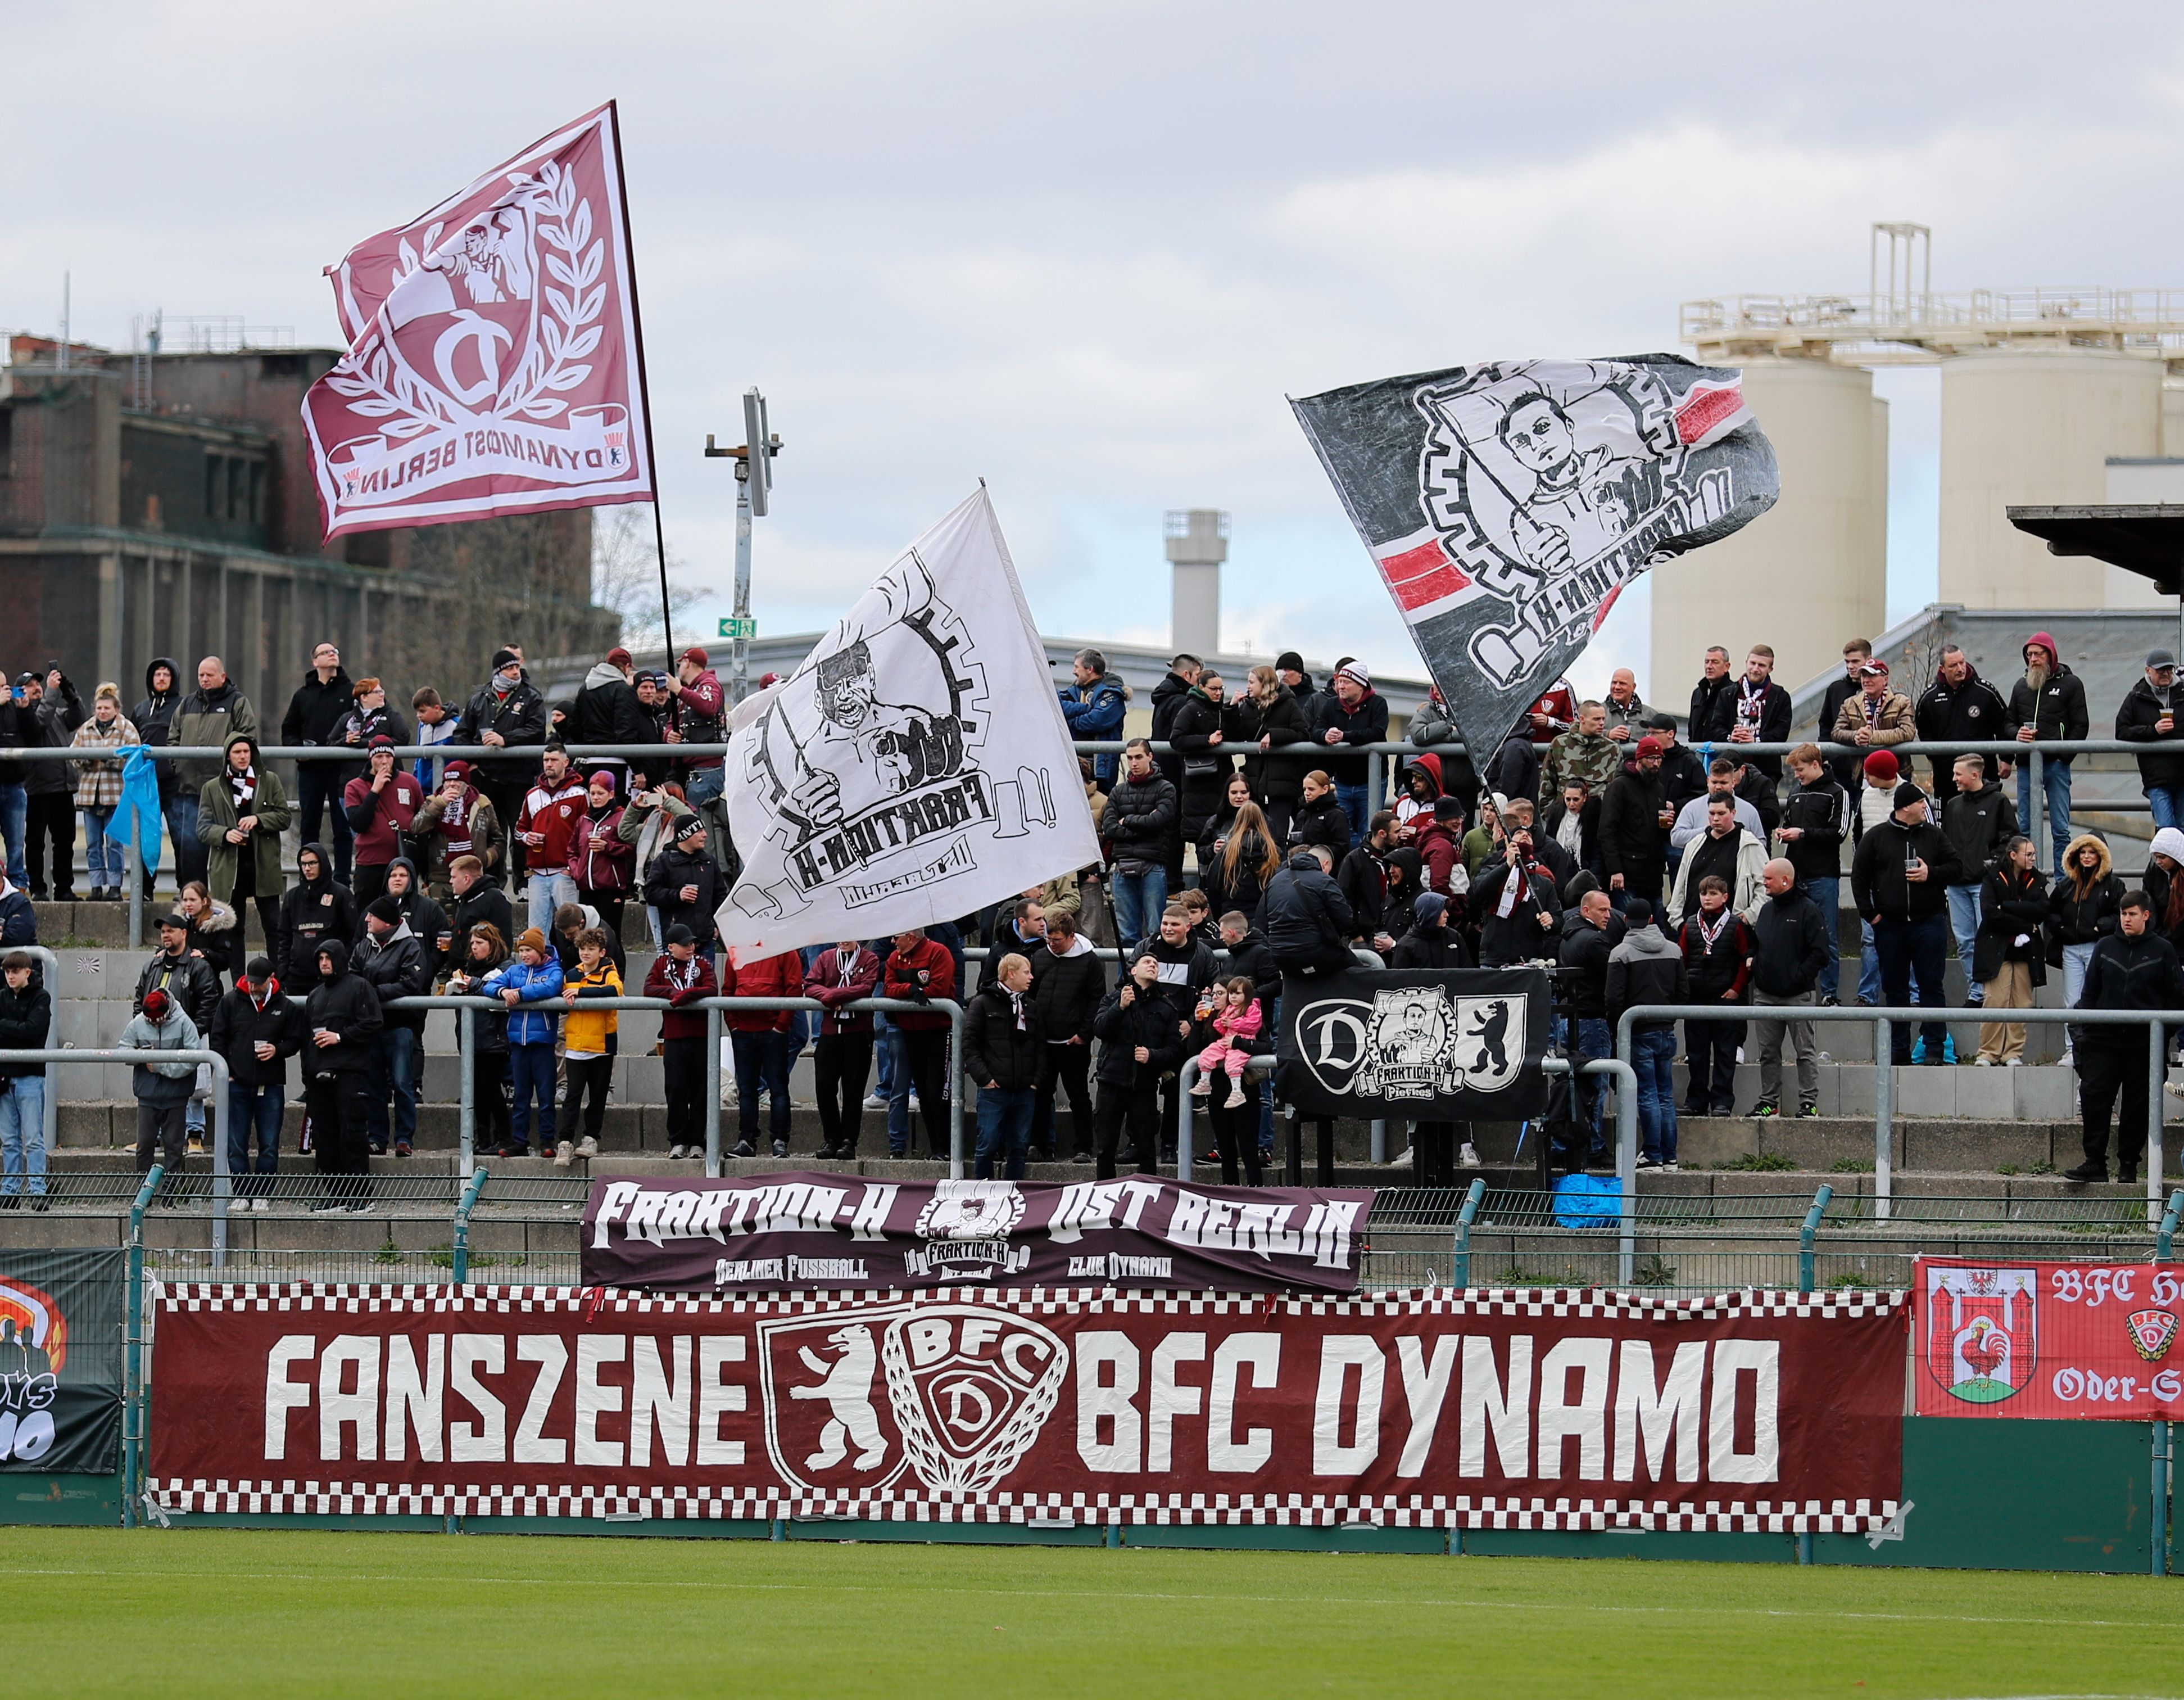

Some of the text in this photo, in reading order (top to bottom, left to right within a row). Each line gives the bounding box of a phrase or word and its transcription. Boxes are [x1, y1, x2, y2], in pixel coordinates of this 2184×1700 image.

[1377, 1066, 1442, 1085] FRAKTION-H
[1388, 1084, 1432, 1099] Piefkes
[590, 1179, 1365, 1270] FRAKTION-H OST BERLIN
[929, 1241, 1006, 1264] FRAKTION-H
[1068, 1251, 1172, 1280] CLUB DYNAMO
[715, 1254, 869, 1285] BERLINER FUSSBALL
[2051, 1269, 2136, 1307] BFC
[2131, 1312, 2173, 1328] BFC
[907, 1318, 1051, 1384] BFC
[264, 1333, 747, 1467] FANSZENE
[2052, 1367, 2184, 1403] Oder-S
[1075, 1330, 1780, 1484] BFC DYNAMO
